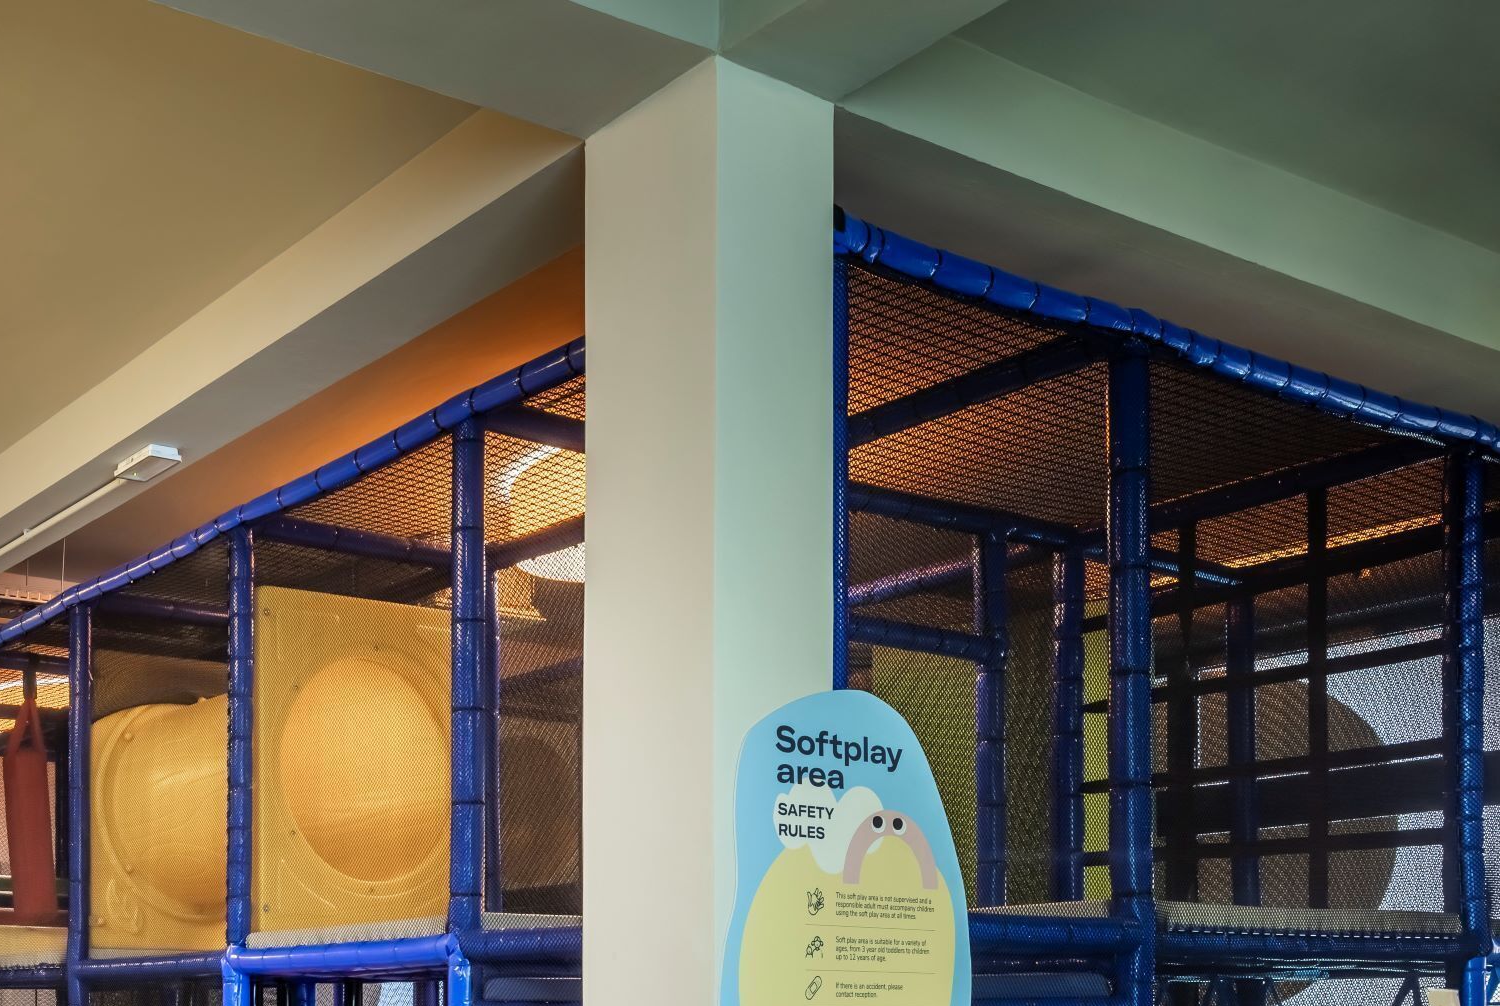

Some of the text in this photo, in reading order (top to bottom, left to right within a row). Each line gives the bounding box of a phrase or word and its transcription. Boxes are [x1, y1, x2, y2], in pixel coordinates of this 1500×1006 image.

[776, 725, 902, 772] Softplay
[777, 764, 844, 789] area
[778, 803, 834, 819] SAFETY
[779, 823, 825, 839] RULES
[869, 911, 878, 919] play
